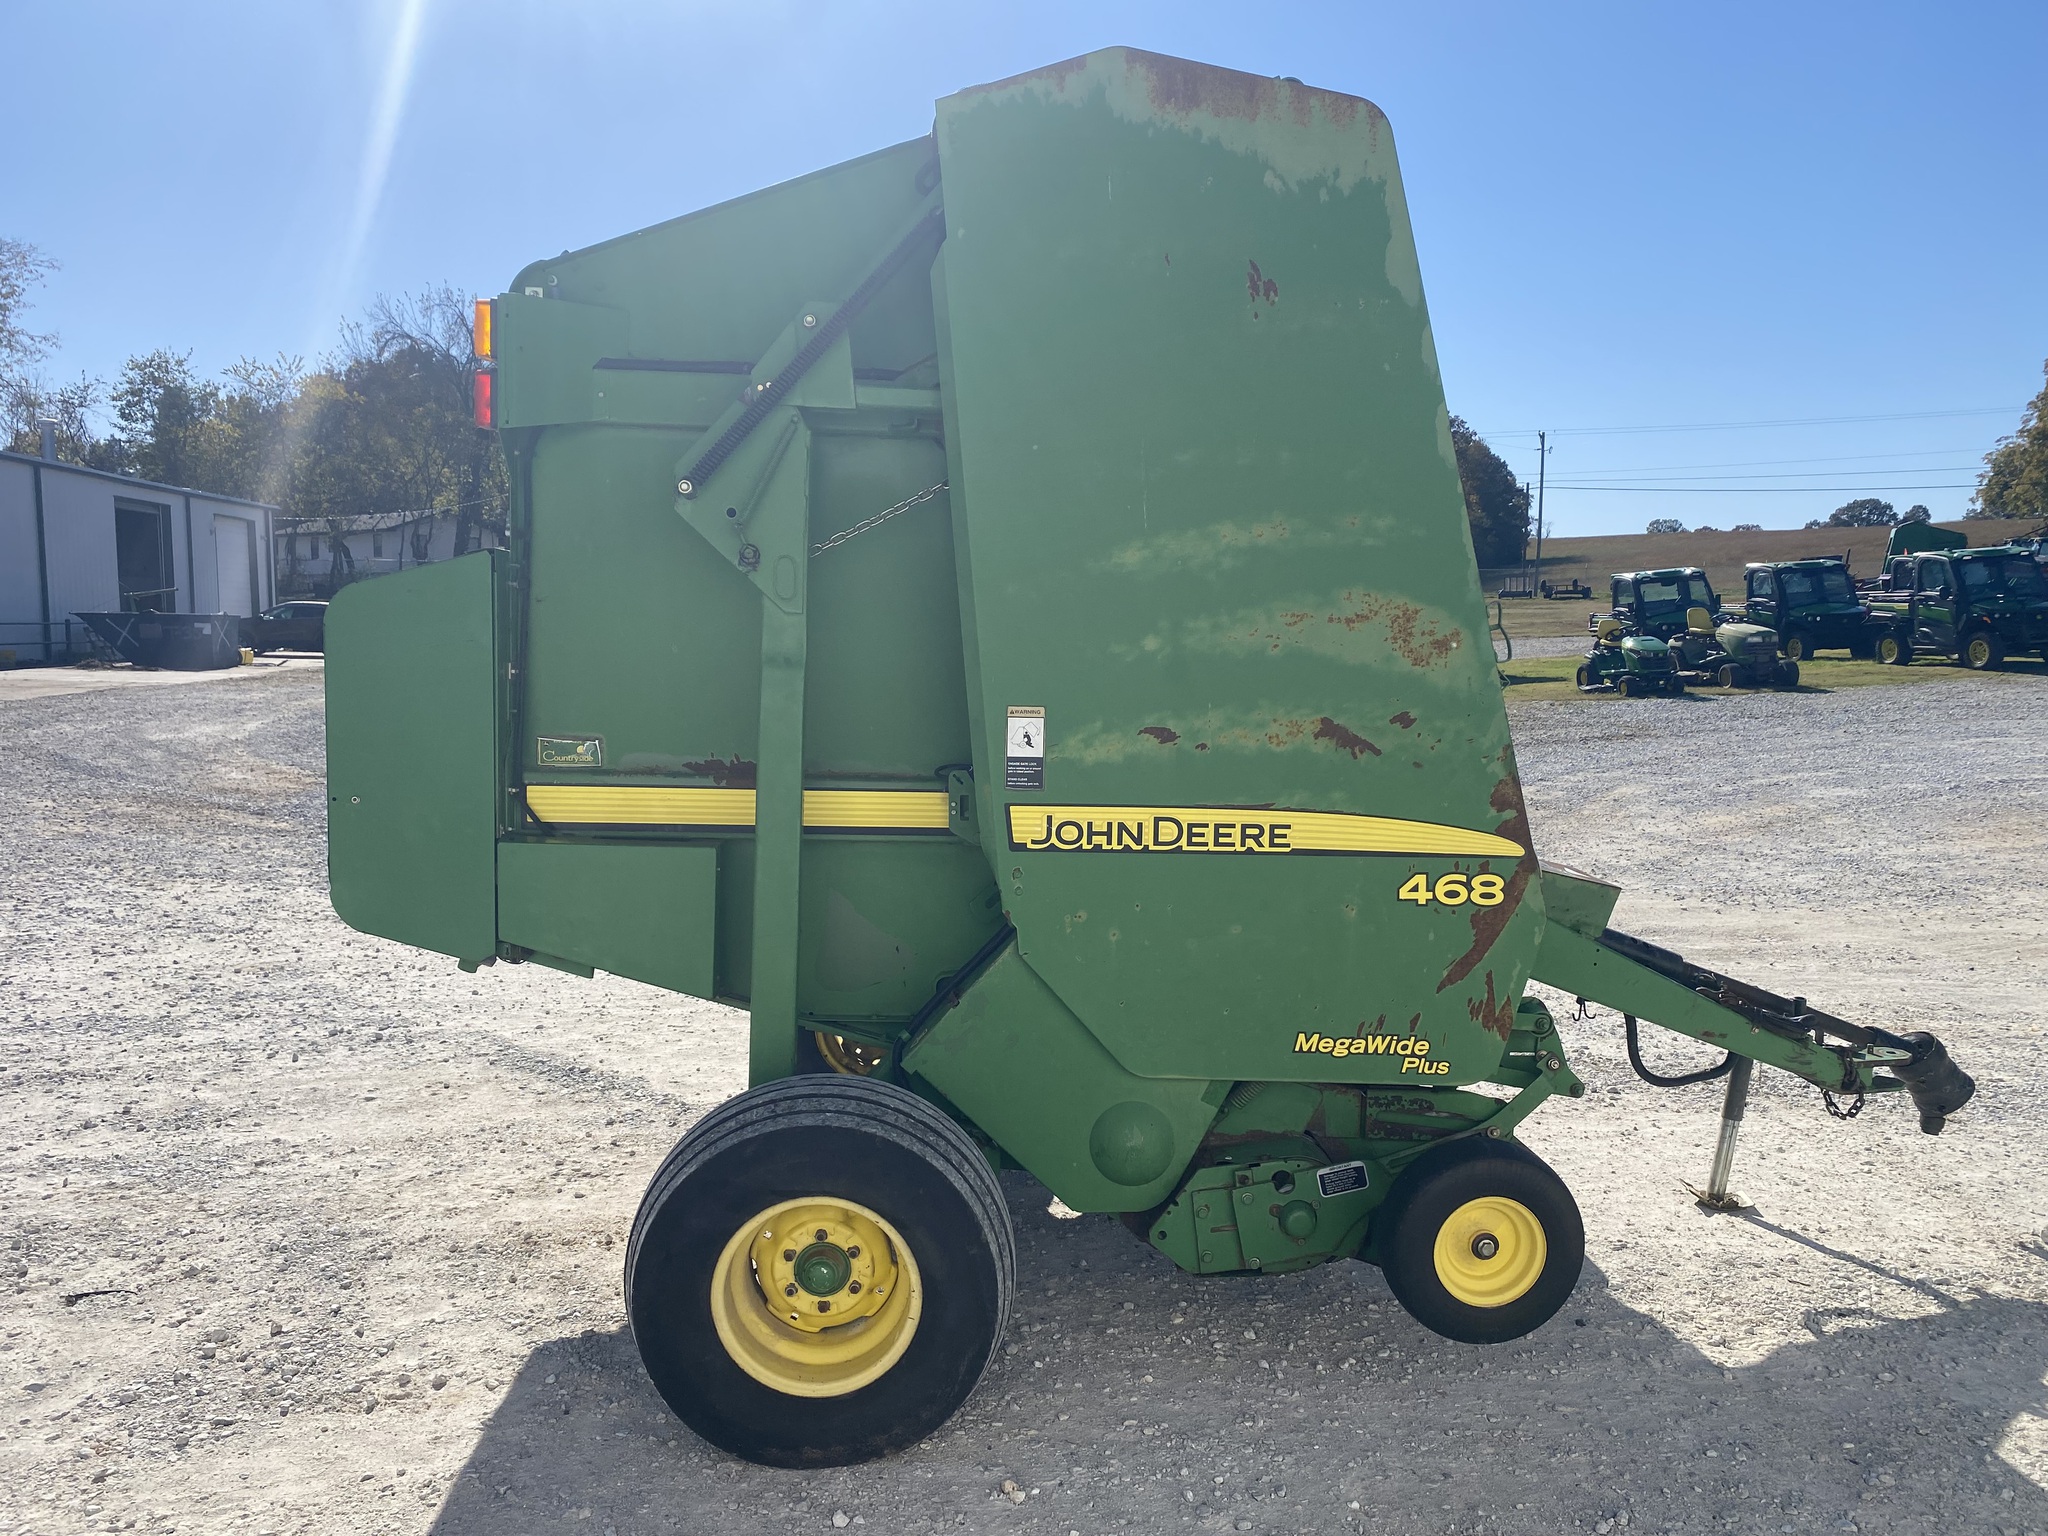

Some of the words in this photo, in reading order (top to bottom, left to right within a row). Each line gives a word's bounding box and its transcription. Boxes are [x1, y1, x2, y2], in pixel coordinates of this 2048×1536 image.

[543, 750, 594, 763] Countryside
[1029, 814, 1144, 847] JOHN
[1152, 815, 1293, 850] DEERE
[1398, 873, 1505, 906] 468
[1294, 1032, 1430, 1057] MegaWide
[1401, 1057, 1450, 1075] Plus
